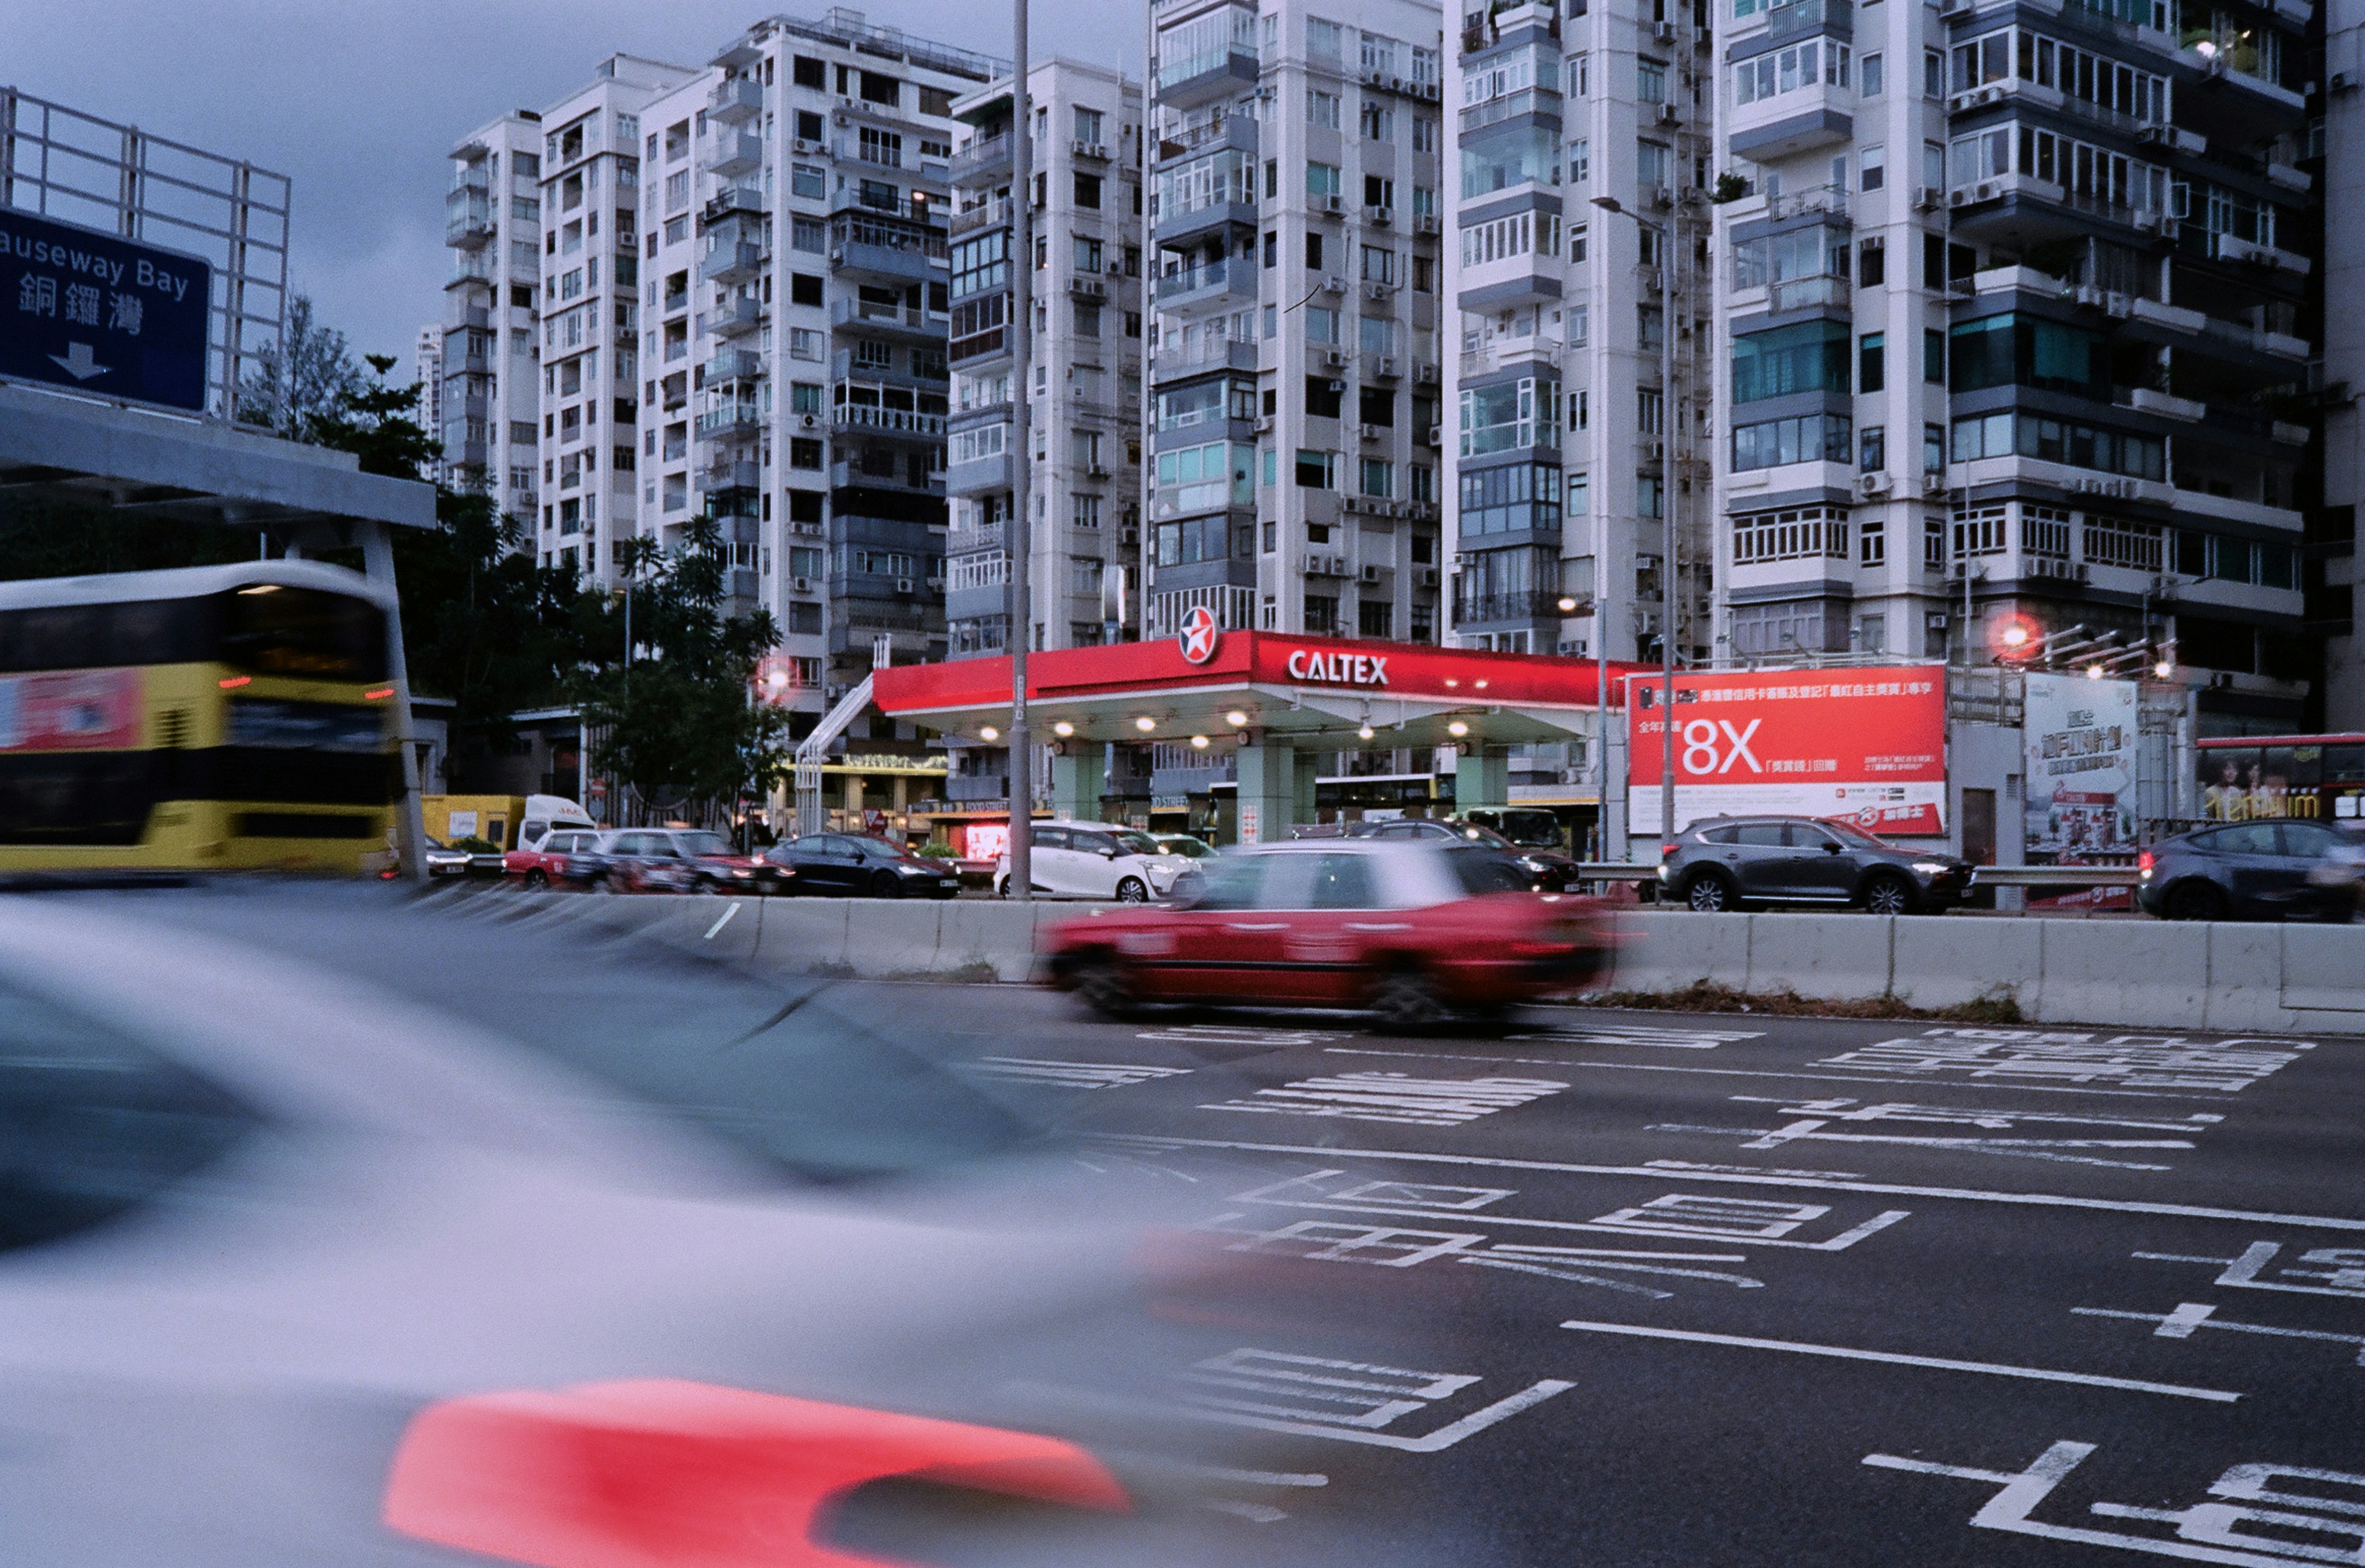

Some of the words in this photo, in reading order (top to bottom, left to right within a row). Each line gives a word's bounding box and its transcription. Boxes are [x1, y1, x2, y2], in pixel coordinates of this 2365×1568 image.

[19, 272, 143, 336] 銅鑼灣
[137, 259, 189, 301] Bay
[1289, 650, 1388, 684] CALTEX
[1683, 718, 1763, 775] 8X
[966, 802, 984, 812] FOOD
[985, 801, 1008, 811] STREET
[1196, 1071, 1571, 1126] HANG
